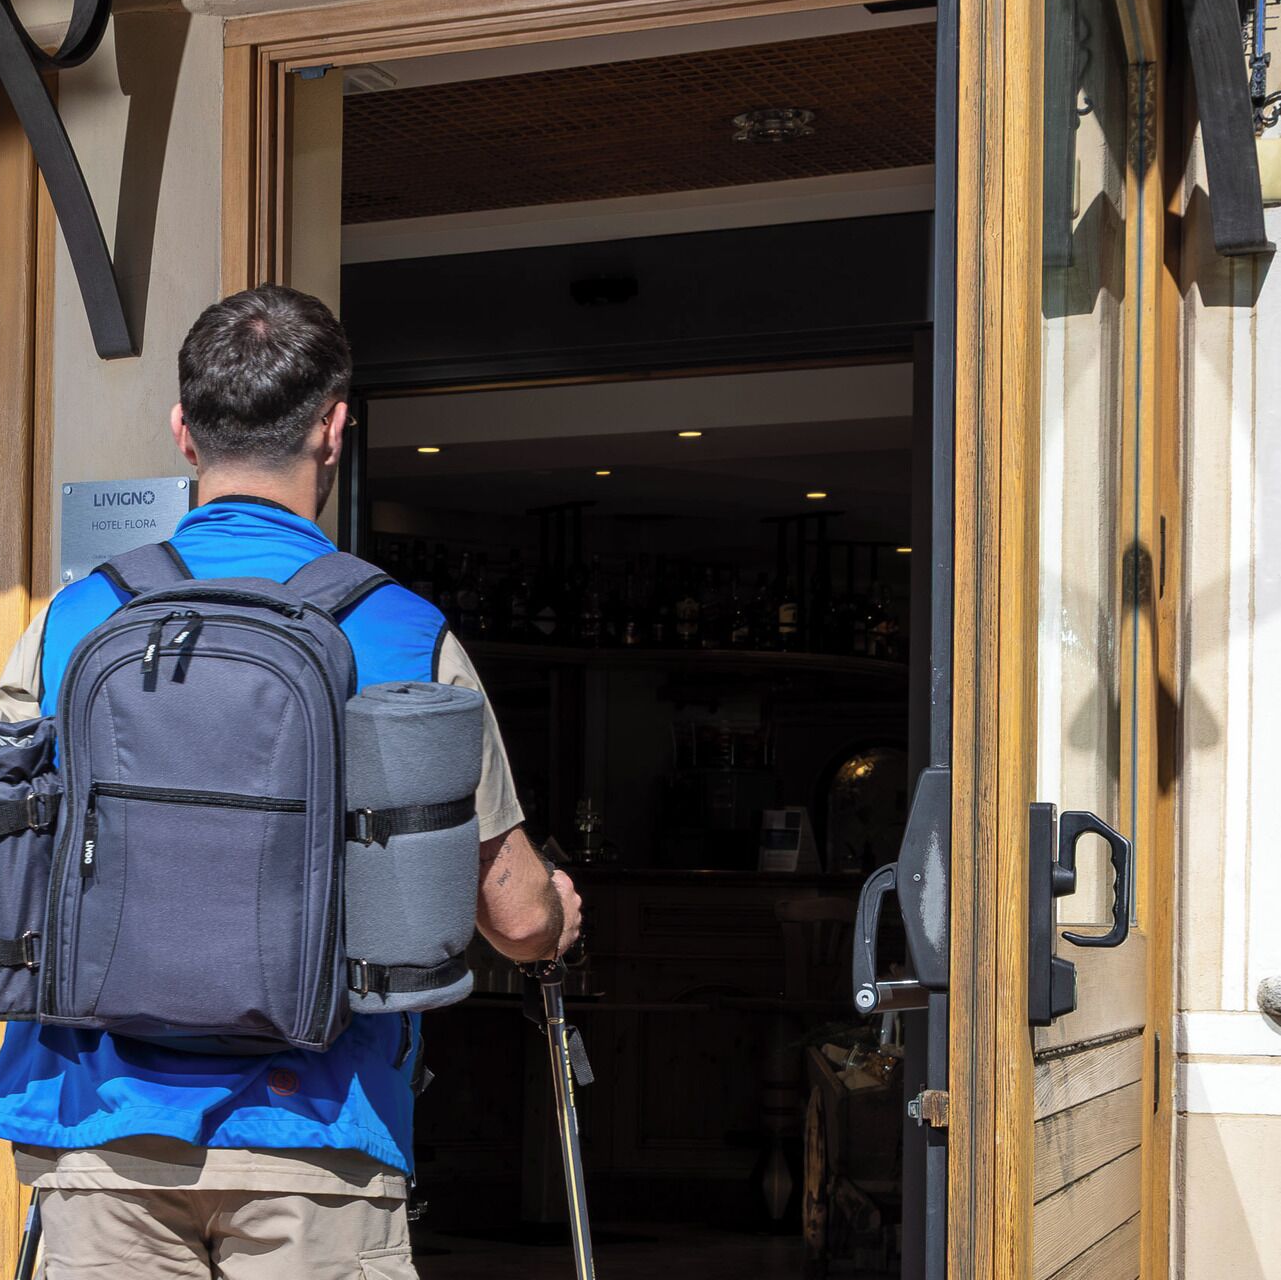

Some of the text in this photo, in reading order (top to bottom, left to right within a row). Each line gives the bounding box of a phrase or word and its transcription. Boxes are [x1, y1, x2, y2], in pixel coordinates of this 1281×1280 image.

[94, 490, 155, 507] LIVIGNO
[91, 519, 157, 530] HOTEL FLORA
